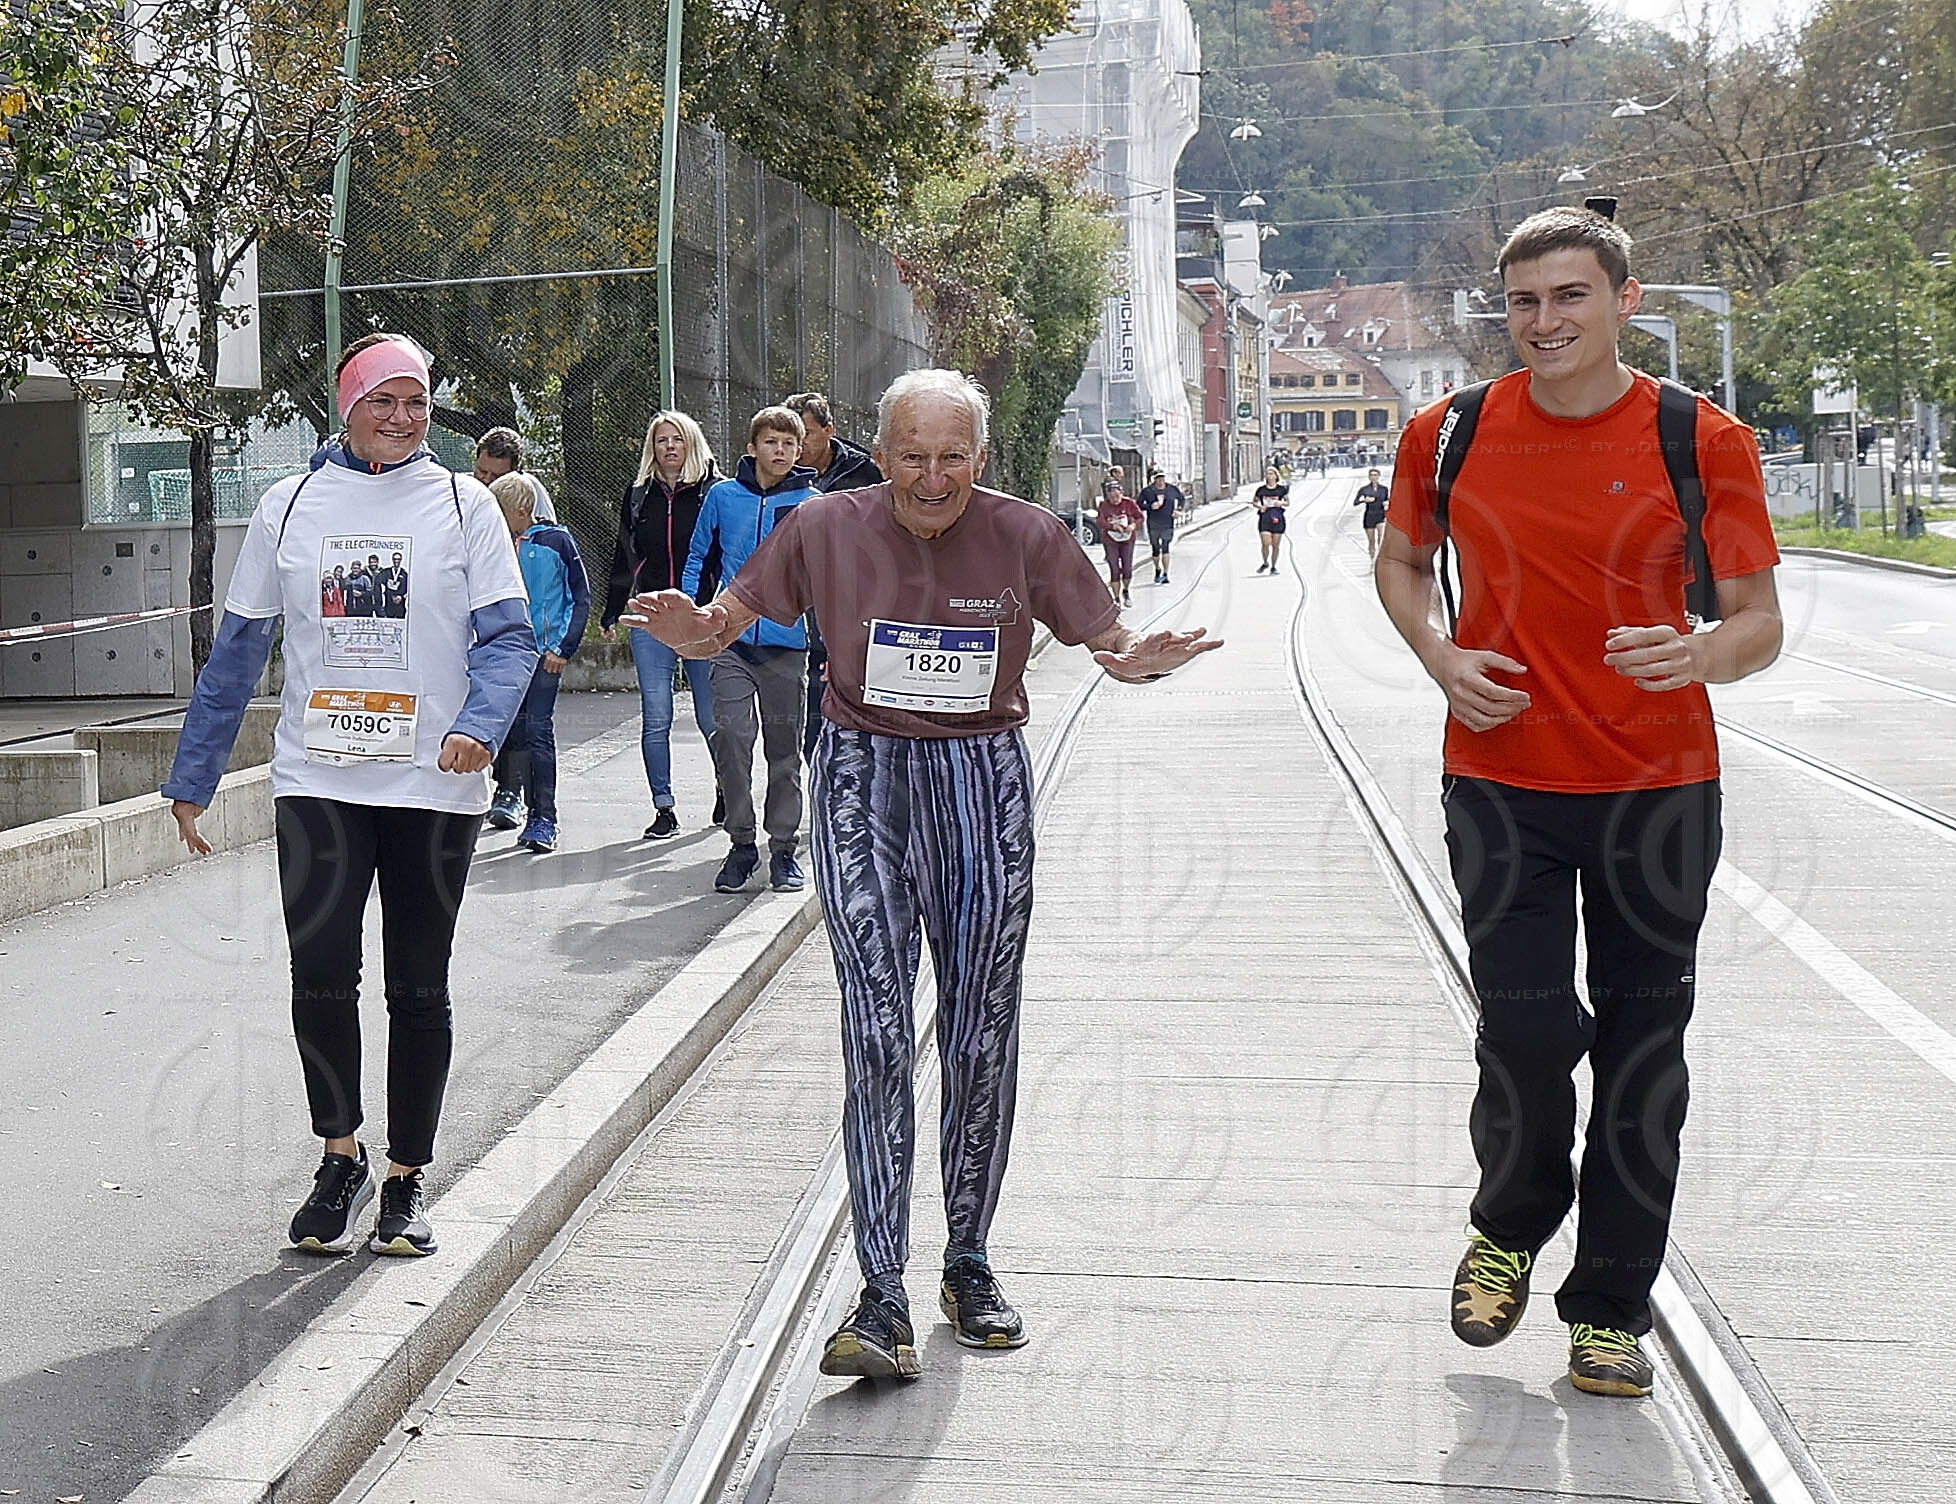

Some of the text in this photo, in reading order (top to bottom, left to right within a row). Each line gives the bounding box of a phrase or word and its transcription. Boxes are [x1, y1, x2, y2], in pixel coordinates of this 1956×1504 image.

[1122, 290, 1133, 372] PICHLER
[329, 541, 343, 549] THE
[966, 599, 996, 608] GRAZ
[905, 652, 961, 673] 1820
[327, 714, 391, 734] 7059C
[347, 743, 366, 752] Lena
